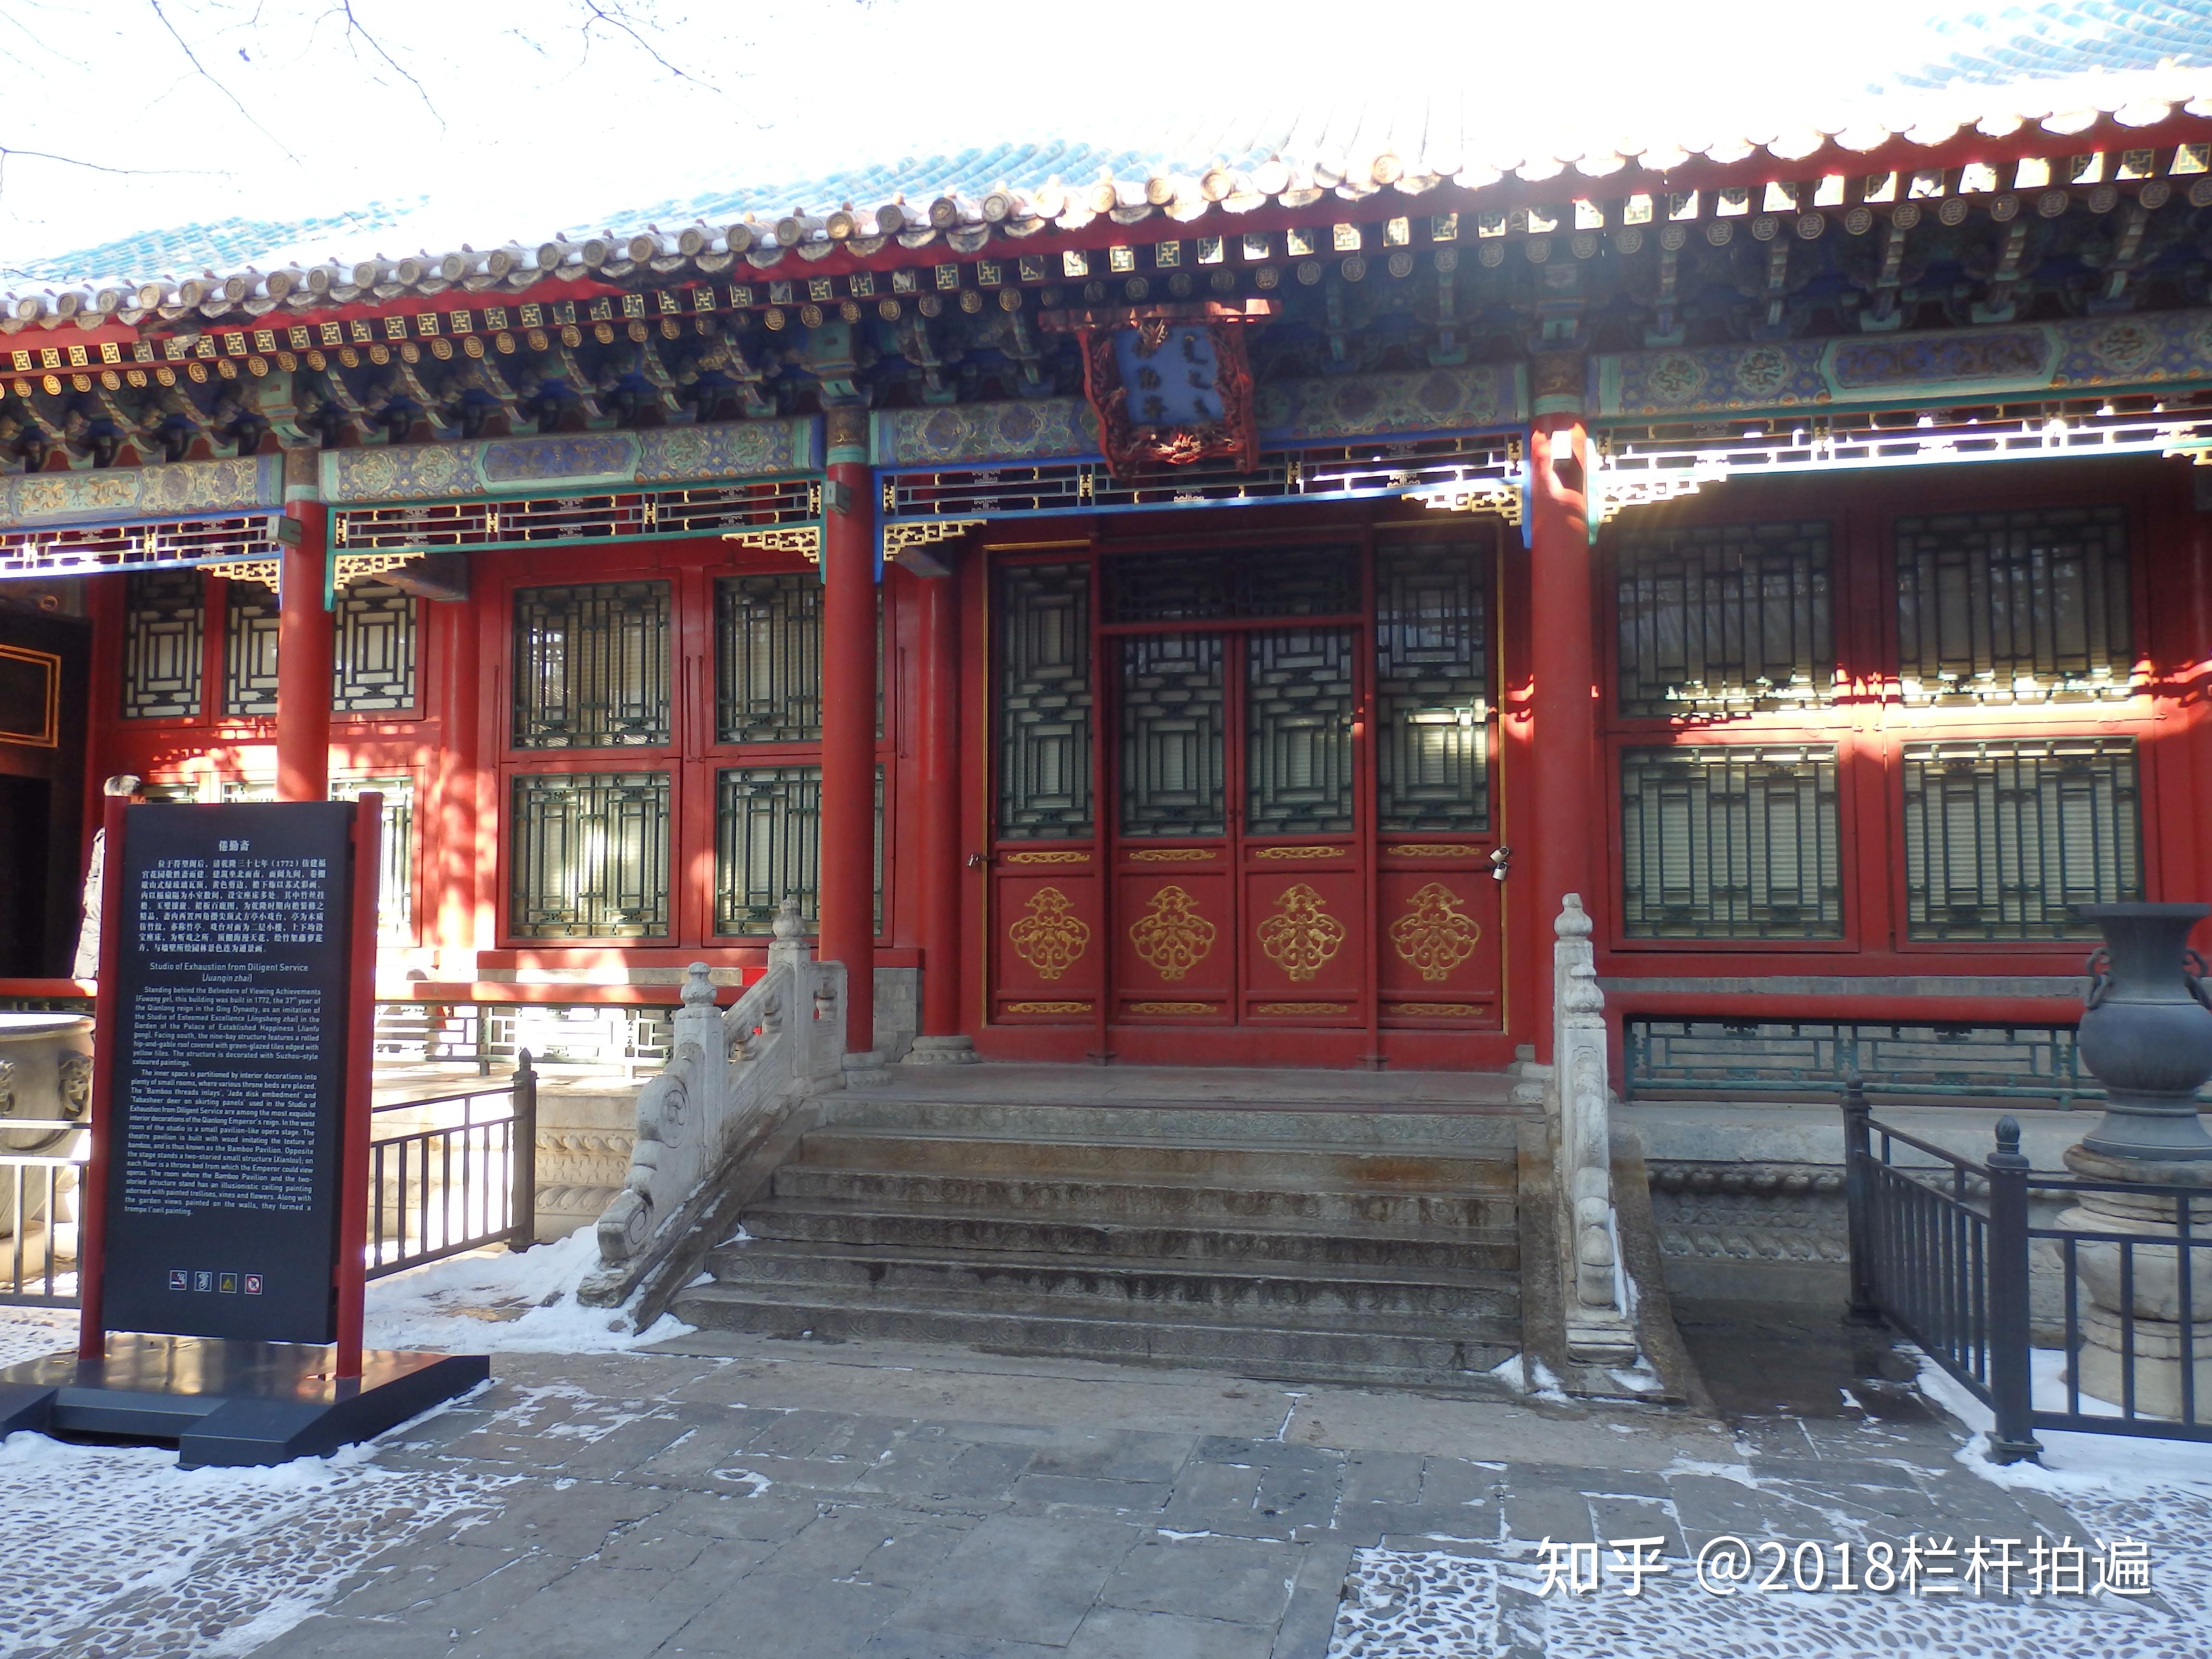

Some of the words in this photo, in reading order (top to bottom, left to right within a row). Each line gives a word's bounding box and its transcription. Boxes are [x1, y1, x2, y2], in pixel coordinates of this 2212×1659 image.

[218, 840, 250, 852] 倦勤斋
[247, 963, 278, 972] Diligent
[249, 987, 274, 996] Viewing
[216, 1005, 231, 1013] Qing
[260, 1024, 294, 1033] Happiness
[285, 1043, 304, 1052] edged
[276, 1052, 318, 1061] Suzhou-style
[230, 1071, 238, 1080] by
[292, 1082, 316, 1091] placed.
[289, 1110, 315, 1118] exquisite
[220, 1126, 259, 1135] pavilion-like
[284, 1147, 313, 1156] Opposite
[252, 1164, 280, 1174] Emperor
[261, 1183, 283, 1192] ceiling
[285, 1184, 312, 1193] painting
[277, 1193, 296, 1202] Along
[261, 1202, 276, 1211] they
